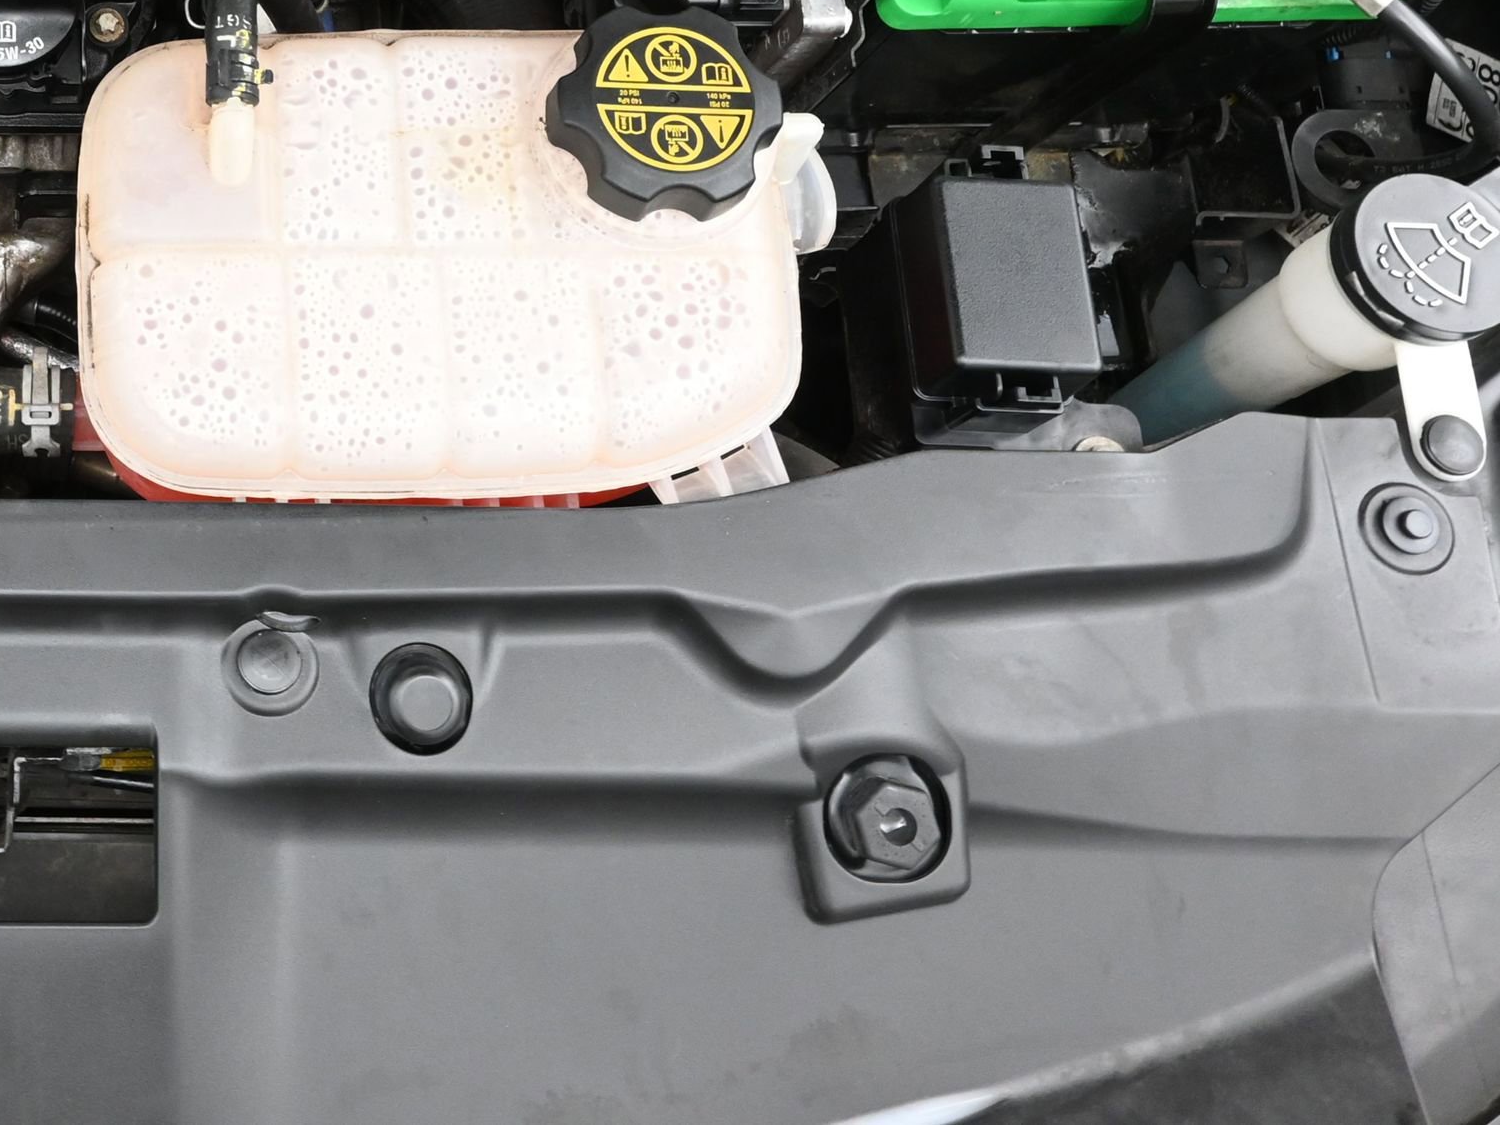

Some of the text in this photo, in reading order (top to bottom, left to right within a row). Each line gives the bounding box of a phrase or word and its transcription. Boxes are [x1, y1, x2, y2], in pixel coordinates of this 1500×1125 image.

[619, 89, 629, 97] 20
[707, 92, 732, 101] 140 kPa
[618, 97, 631, 106] kPa
